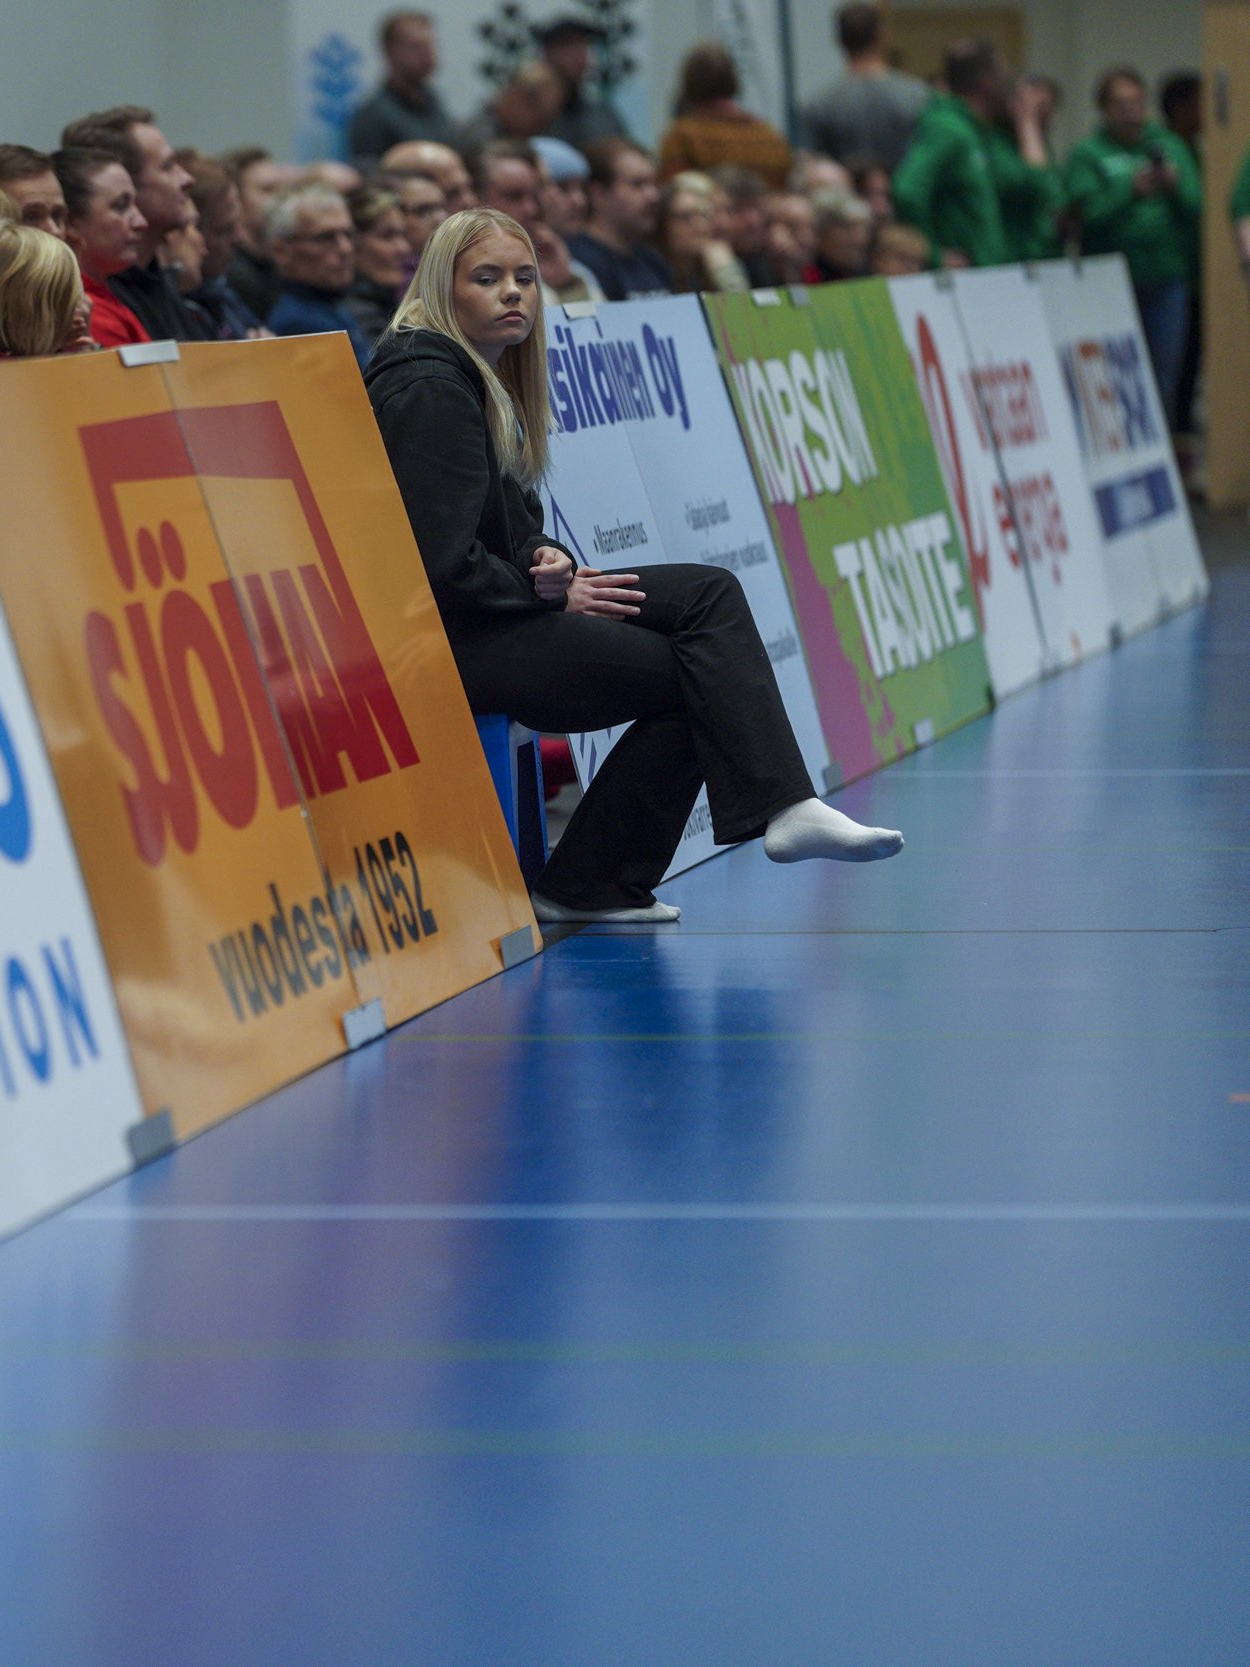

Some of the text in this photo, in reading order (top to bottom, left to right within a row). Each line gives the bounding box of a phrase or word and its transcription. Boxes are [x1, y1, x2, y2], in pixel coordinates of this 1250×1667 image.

[547, 323, 690, 434] sikainen Oy
[730, 349, 879, 507] KORSON
[833, 511, 976, 680] TASOITE
[208, 831, 439, 1024] vuodesta 1952
